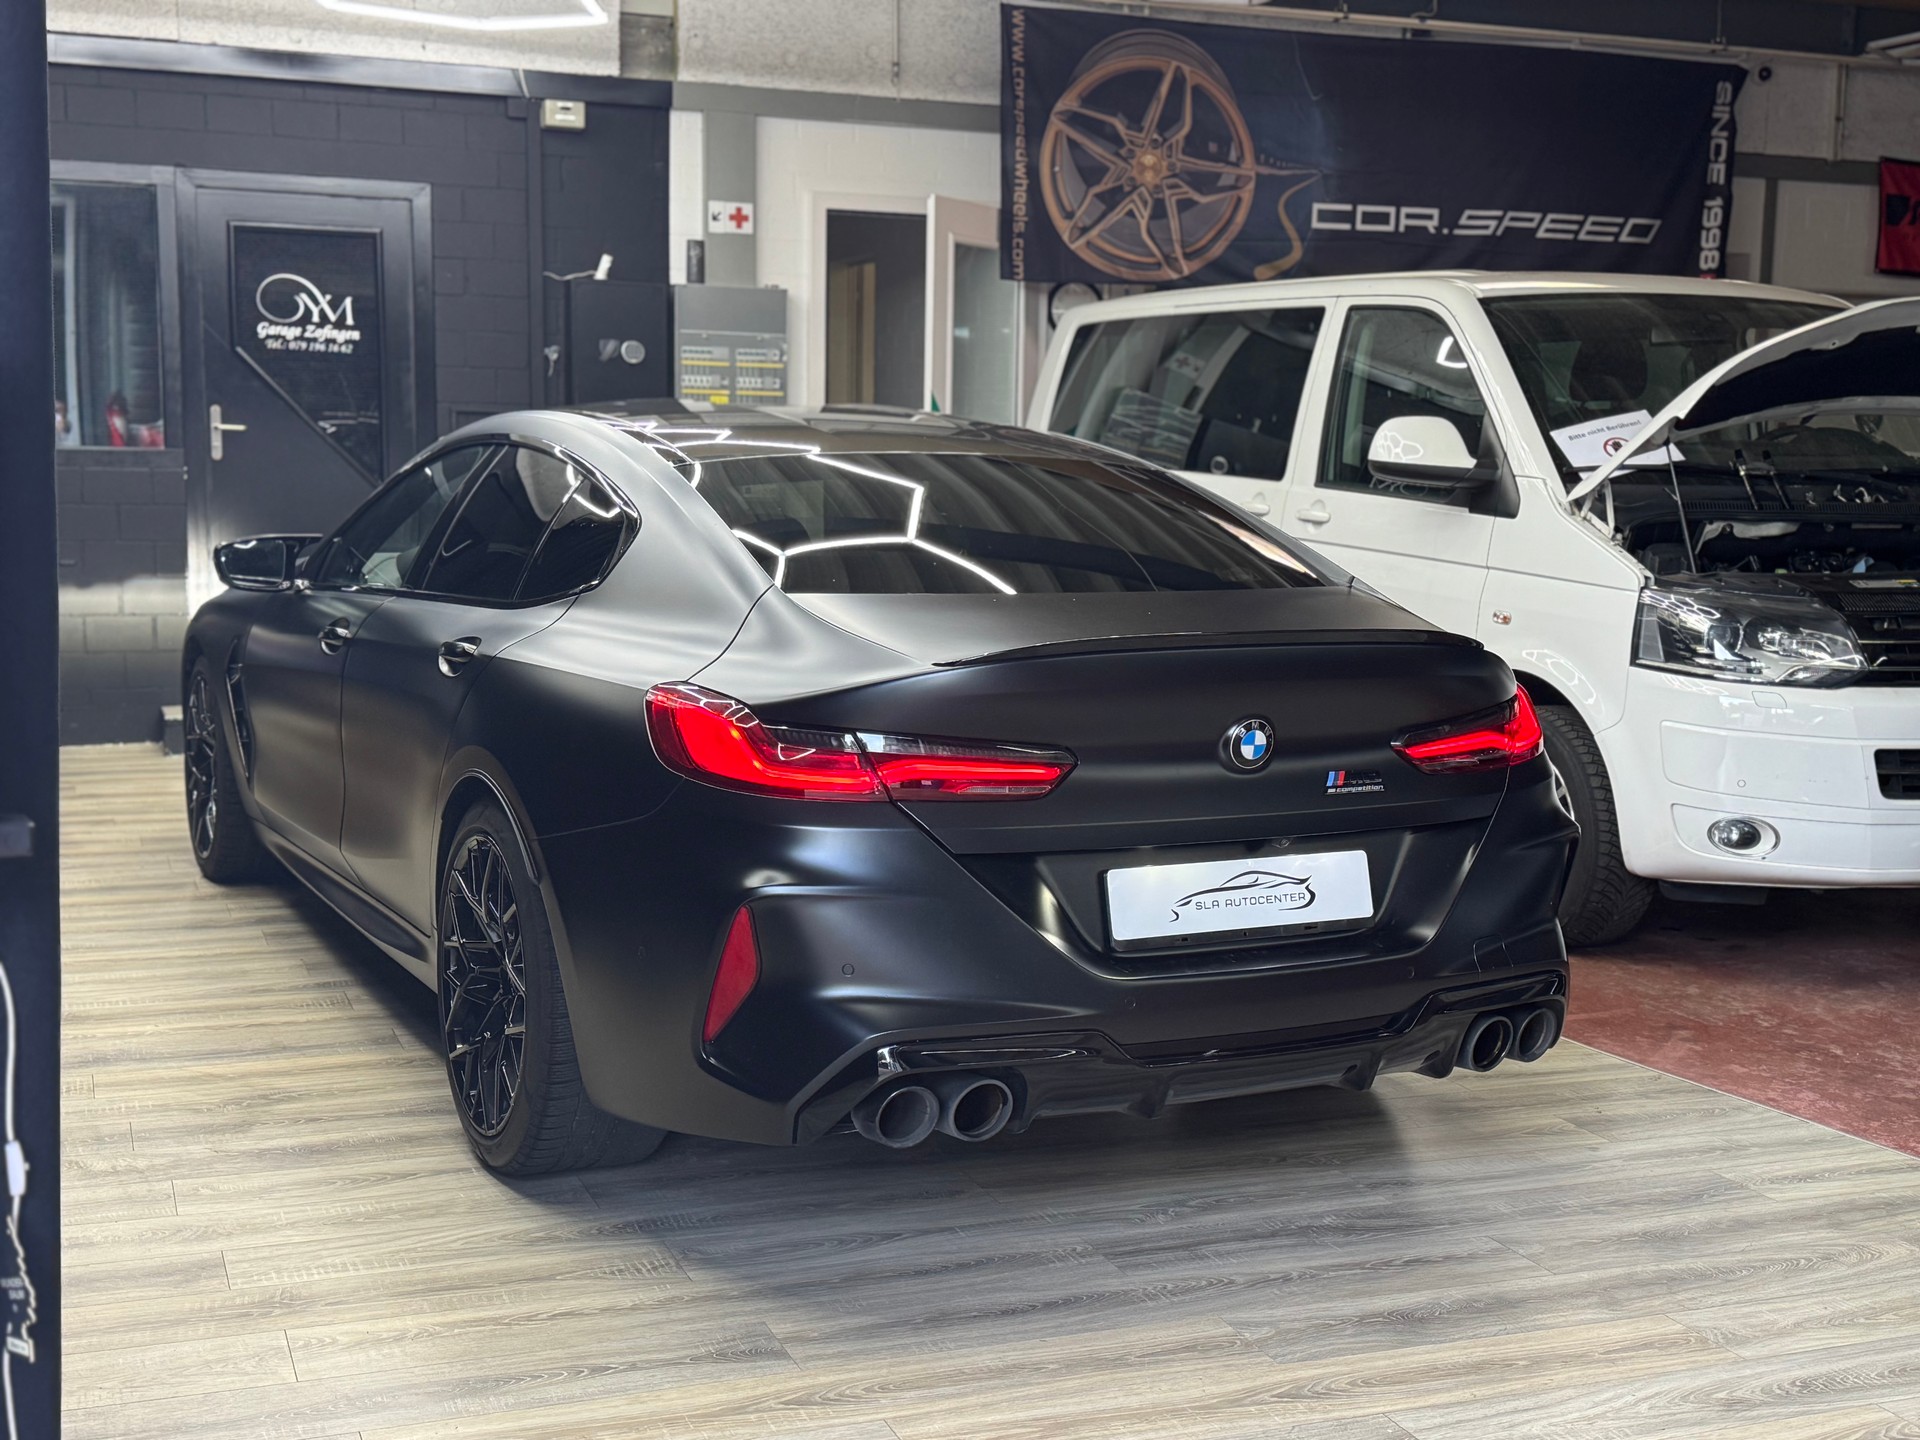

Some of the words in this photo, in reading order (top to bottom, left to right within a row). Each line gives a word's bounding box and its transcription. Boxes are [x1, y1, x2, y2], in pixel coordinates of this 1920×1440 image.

[1706, 80, 1733, 185] SINCE
[1311, 202, 1662, 244] COR.SPEED
[1698, 196, 1724, 271] 1998
[256, 321, 303, 341] Garage
[303, 324, 361, 344] Zofingen
[1568, 433, 1586, 441] Bitte
[1587, 427, 1606, 436] nicht
[1606, 420, 1641, 431] Berühren!
[1237, 720, 1272, 738] BMW
[1195, 899, 1220, 911] SLA
[1225, 892, 1307, 908] AUTOCENTER
